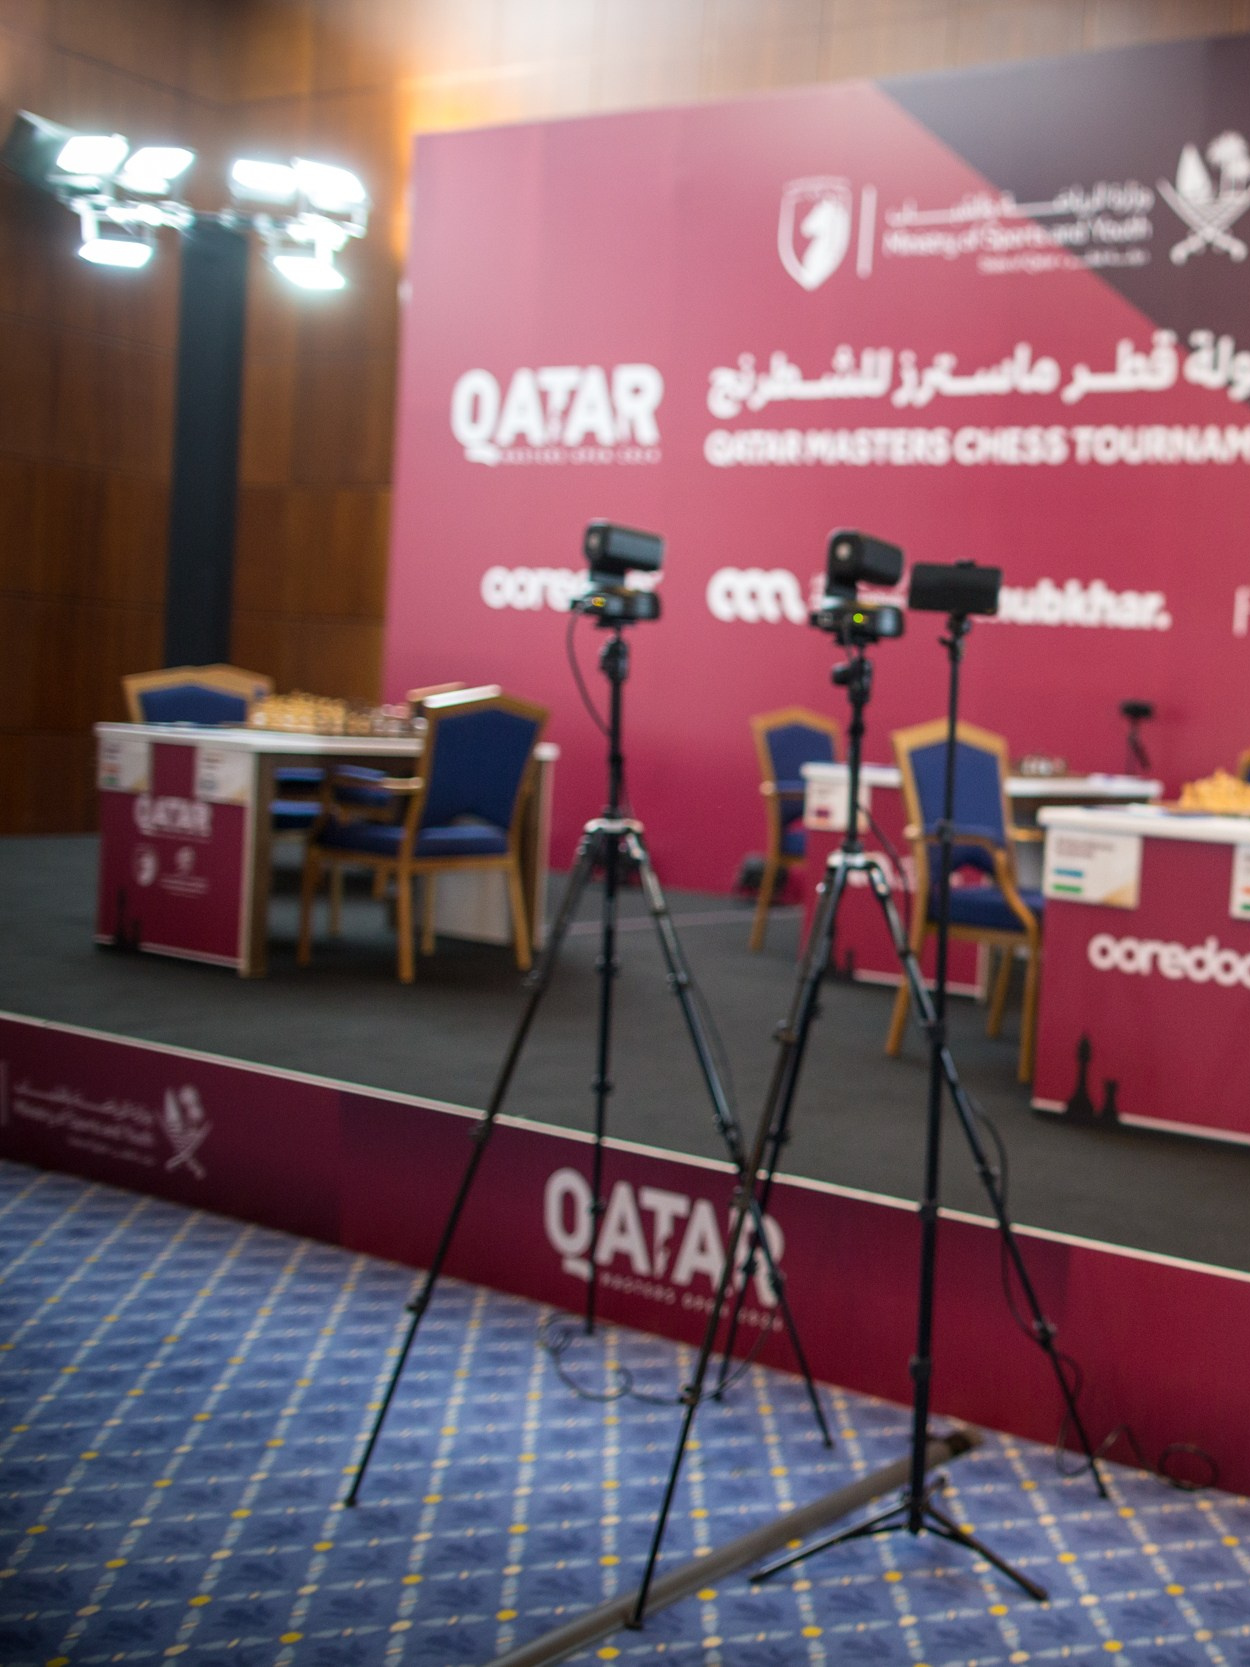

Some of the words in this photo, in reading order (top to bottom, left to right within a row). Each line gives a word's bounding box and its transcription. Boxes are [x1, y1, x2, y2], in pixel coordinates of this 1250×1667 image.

[707, 345, 894, 418] للشطرنج
[892, 340, 1061, 408] ماسترز
[1061, 329, 1179, 404] قطر
[451, 363, 664, 467] QATAR
[704, 430, 799, 466] QATAR
[803, 429, 952, 465] MASTERS
[954, 426, 1071, 464] CHESS
[545, 1168, 784, 1307] QATAR
